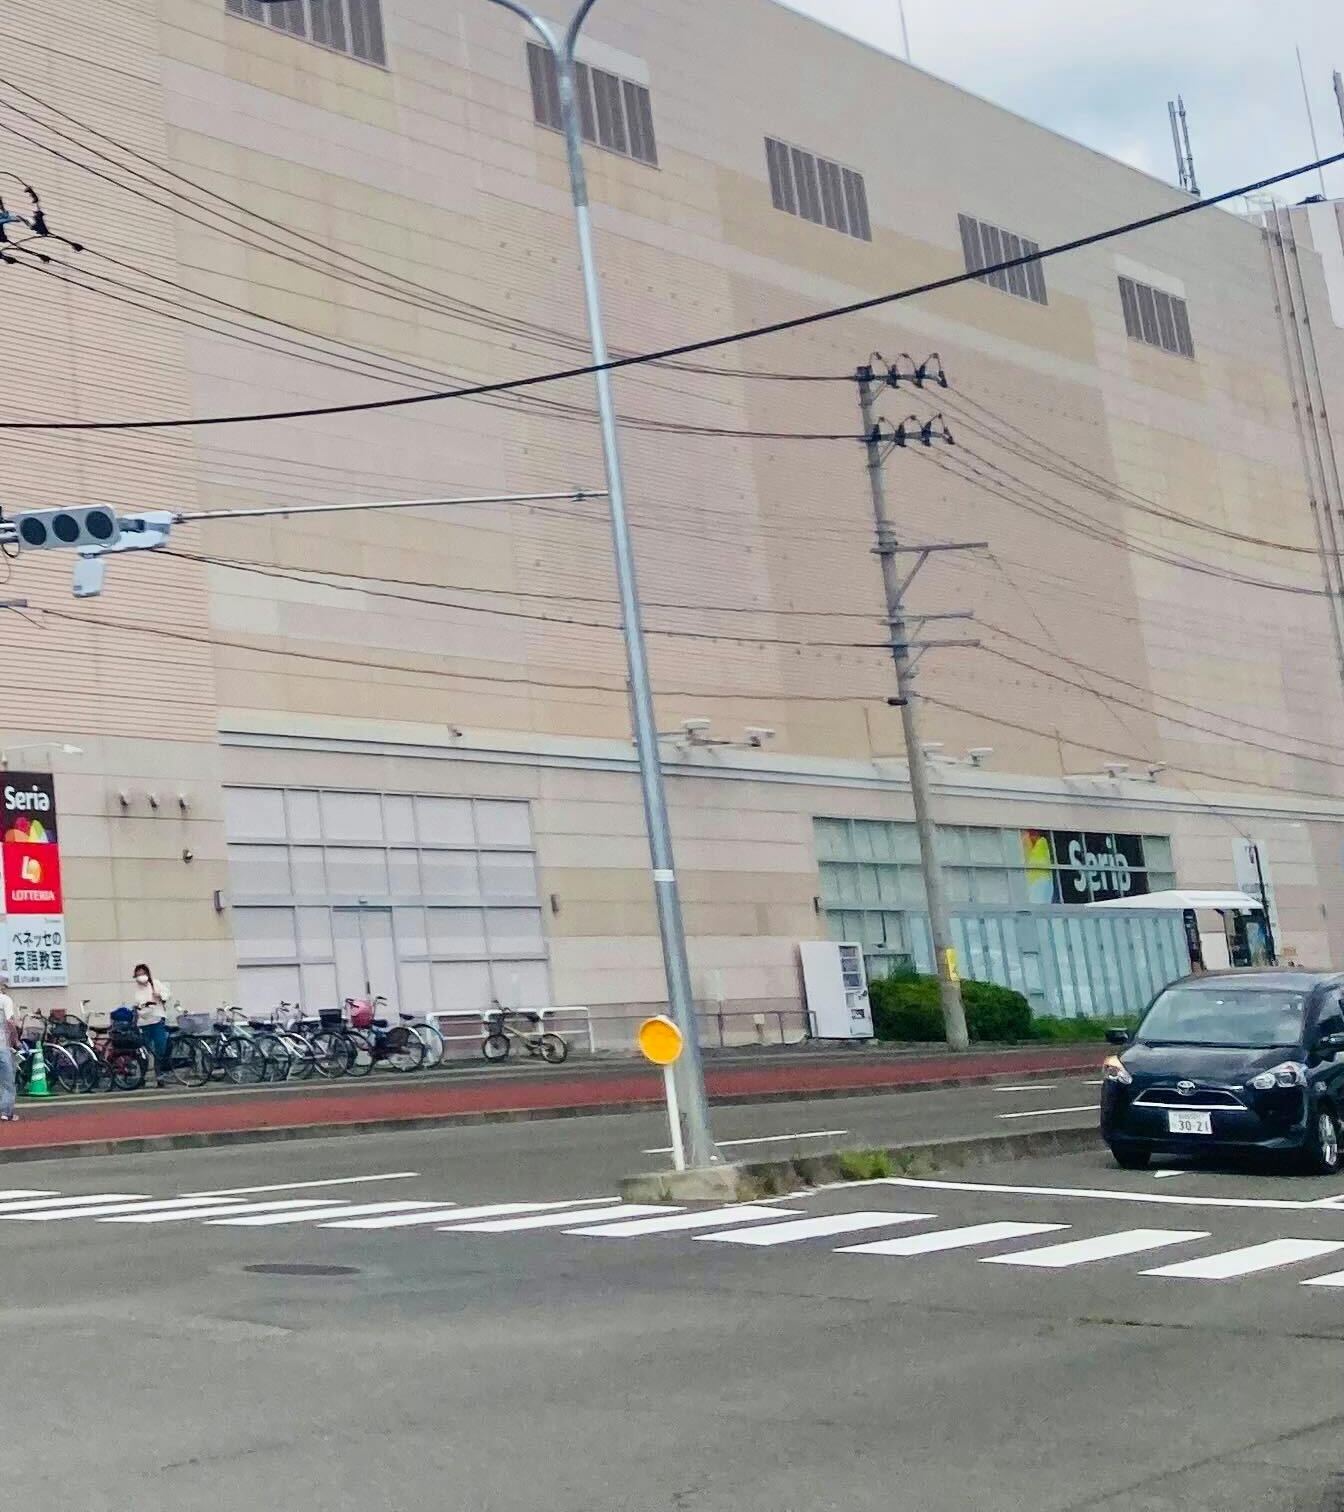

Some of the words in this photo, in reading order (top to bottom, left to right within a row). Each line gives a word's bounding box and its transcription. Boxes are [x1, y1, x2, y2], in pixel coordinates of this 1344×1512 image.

[4, 785, 50, 811] Seria
[13, 932, 61, 947] ベネッセの
[14, 950, 63, 971] 英語教室
